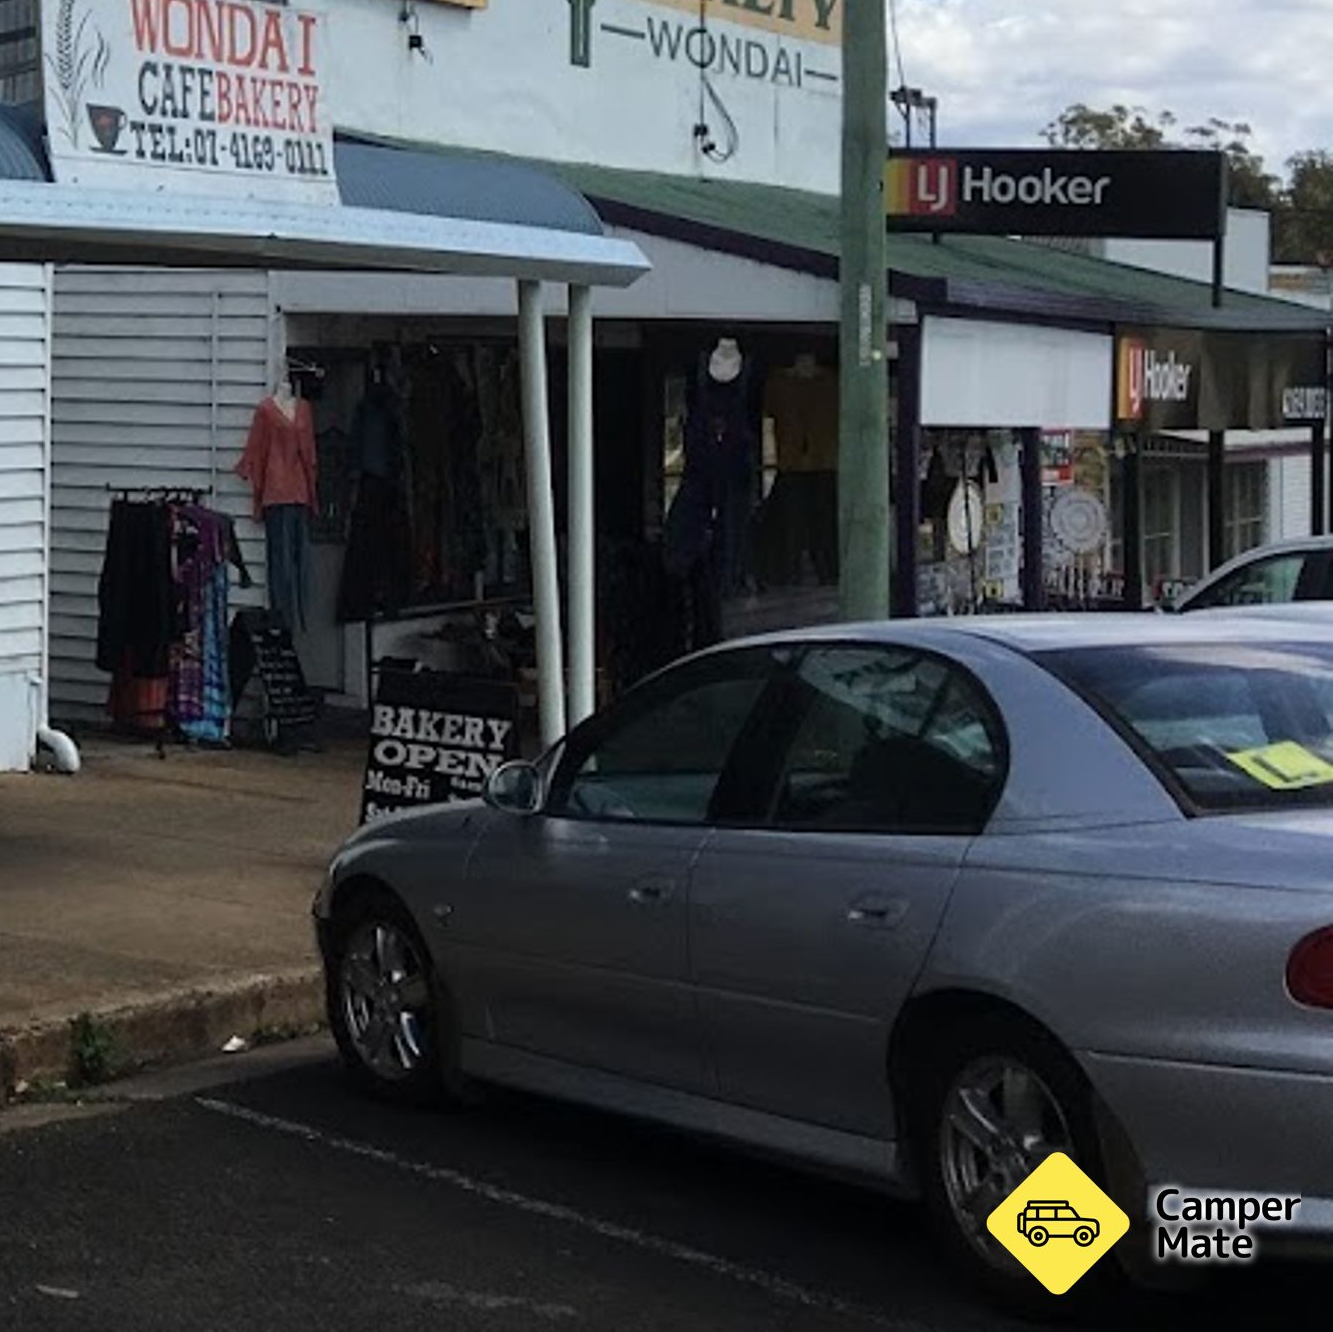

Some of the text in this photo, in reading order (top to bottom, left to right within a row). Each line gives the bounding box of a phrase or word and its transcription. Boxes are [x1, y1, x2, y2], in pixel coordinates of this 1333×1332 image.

[646, 17, 802, 88] WONDAI
[962, 165, 1112, 205] Hooker
[1144, 349, 1192, 401] Hooker
[370, 704, 513, 750] BAKERY
[373, 739, 504, 778] OPEN
